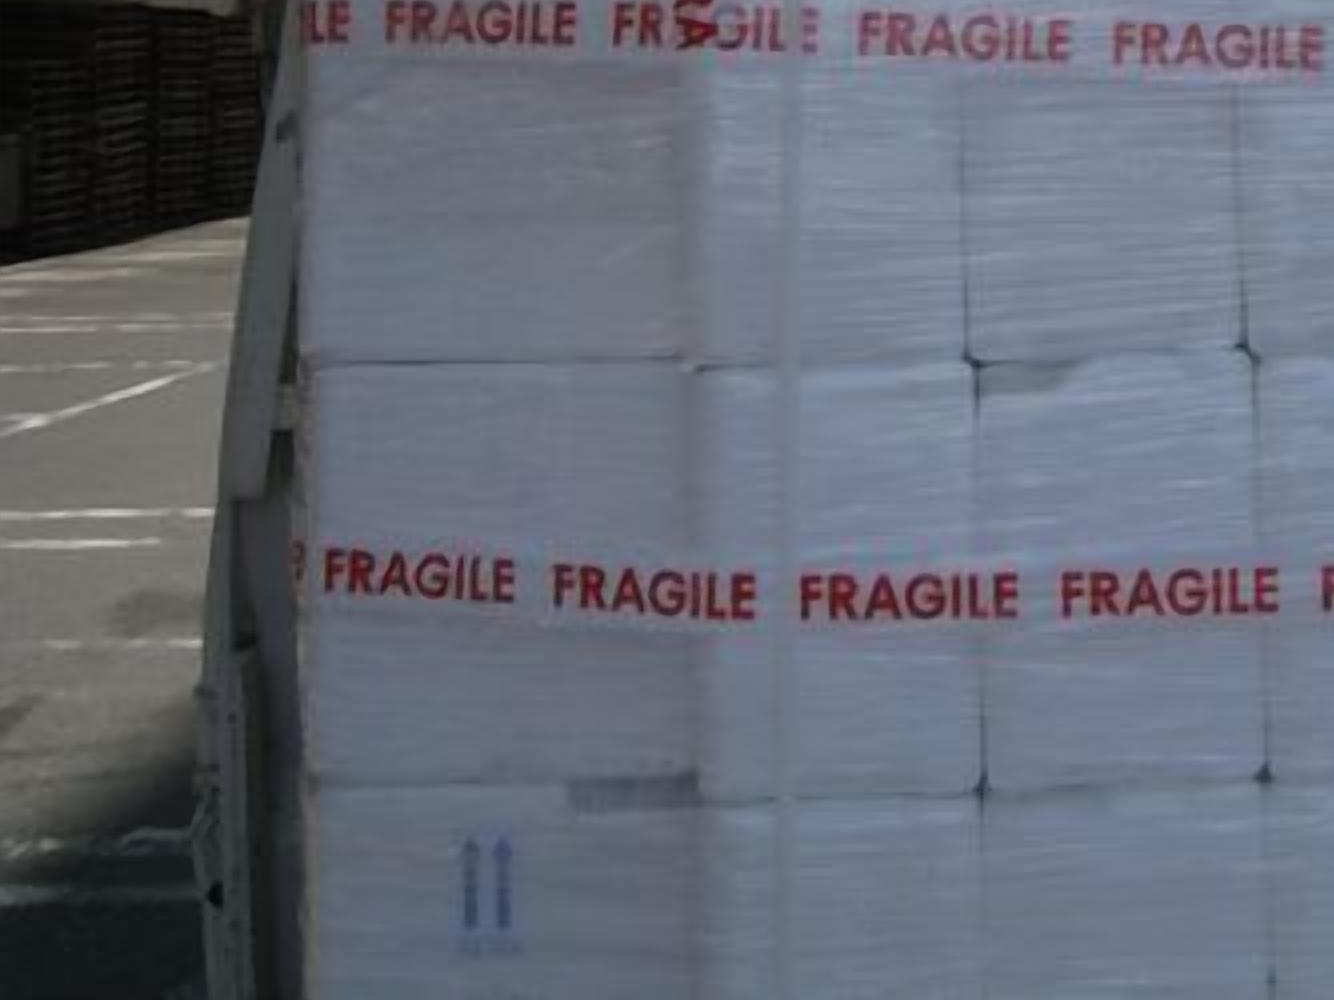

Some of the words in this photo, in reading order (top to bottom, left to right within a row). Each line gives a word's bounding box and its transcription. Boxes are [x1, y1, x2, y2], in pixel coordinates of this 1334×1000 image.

[856, 11, 1074, 63] FRAGILE
[1113, 21, 1325, 72] FRAGILE
[324, 546, 516, 604] FRAGILE
[553, 563, 757, 622] FRAGILE
[801, 572, 1020, 621] FRAGILE
[1060, 566, 1280, 617] FRAGILE
